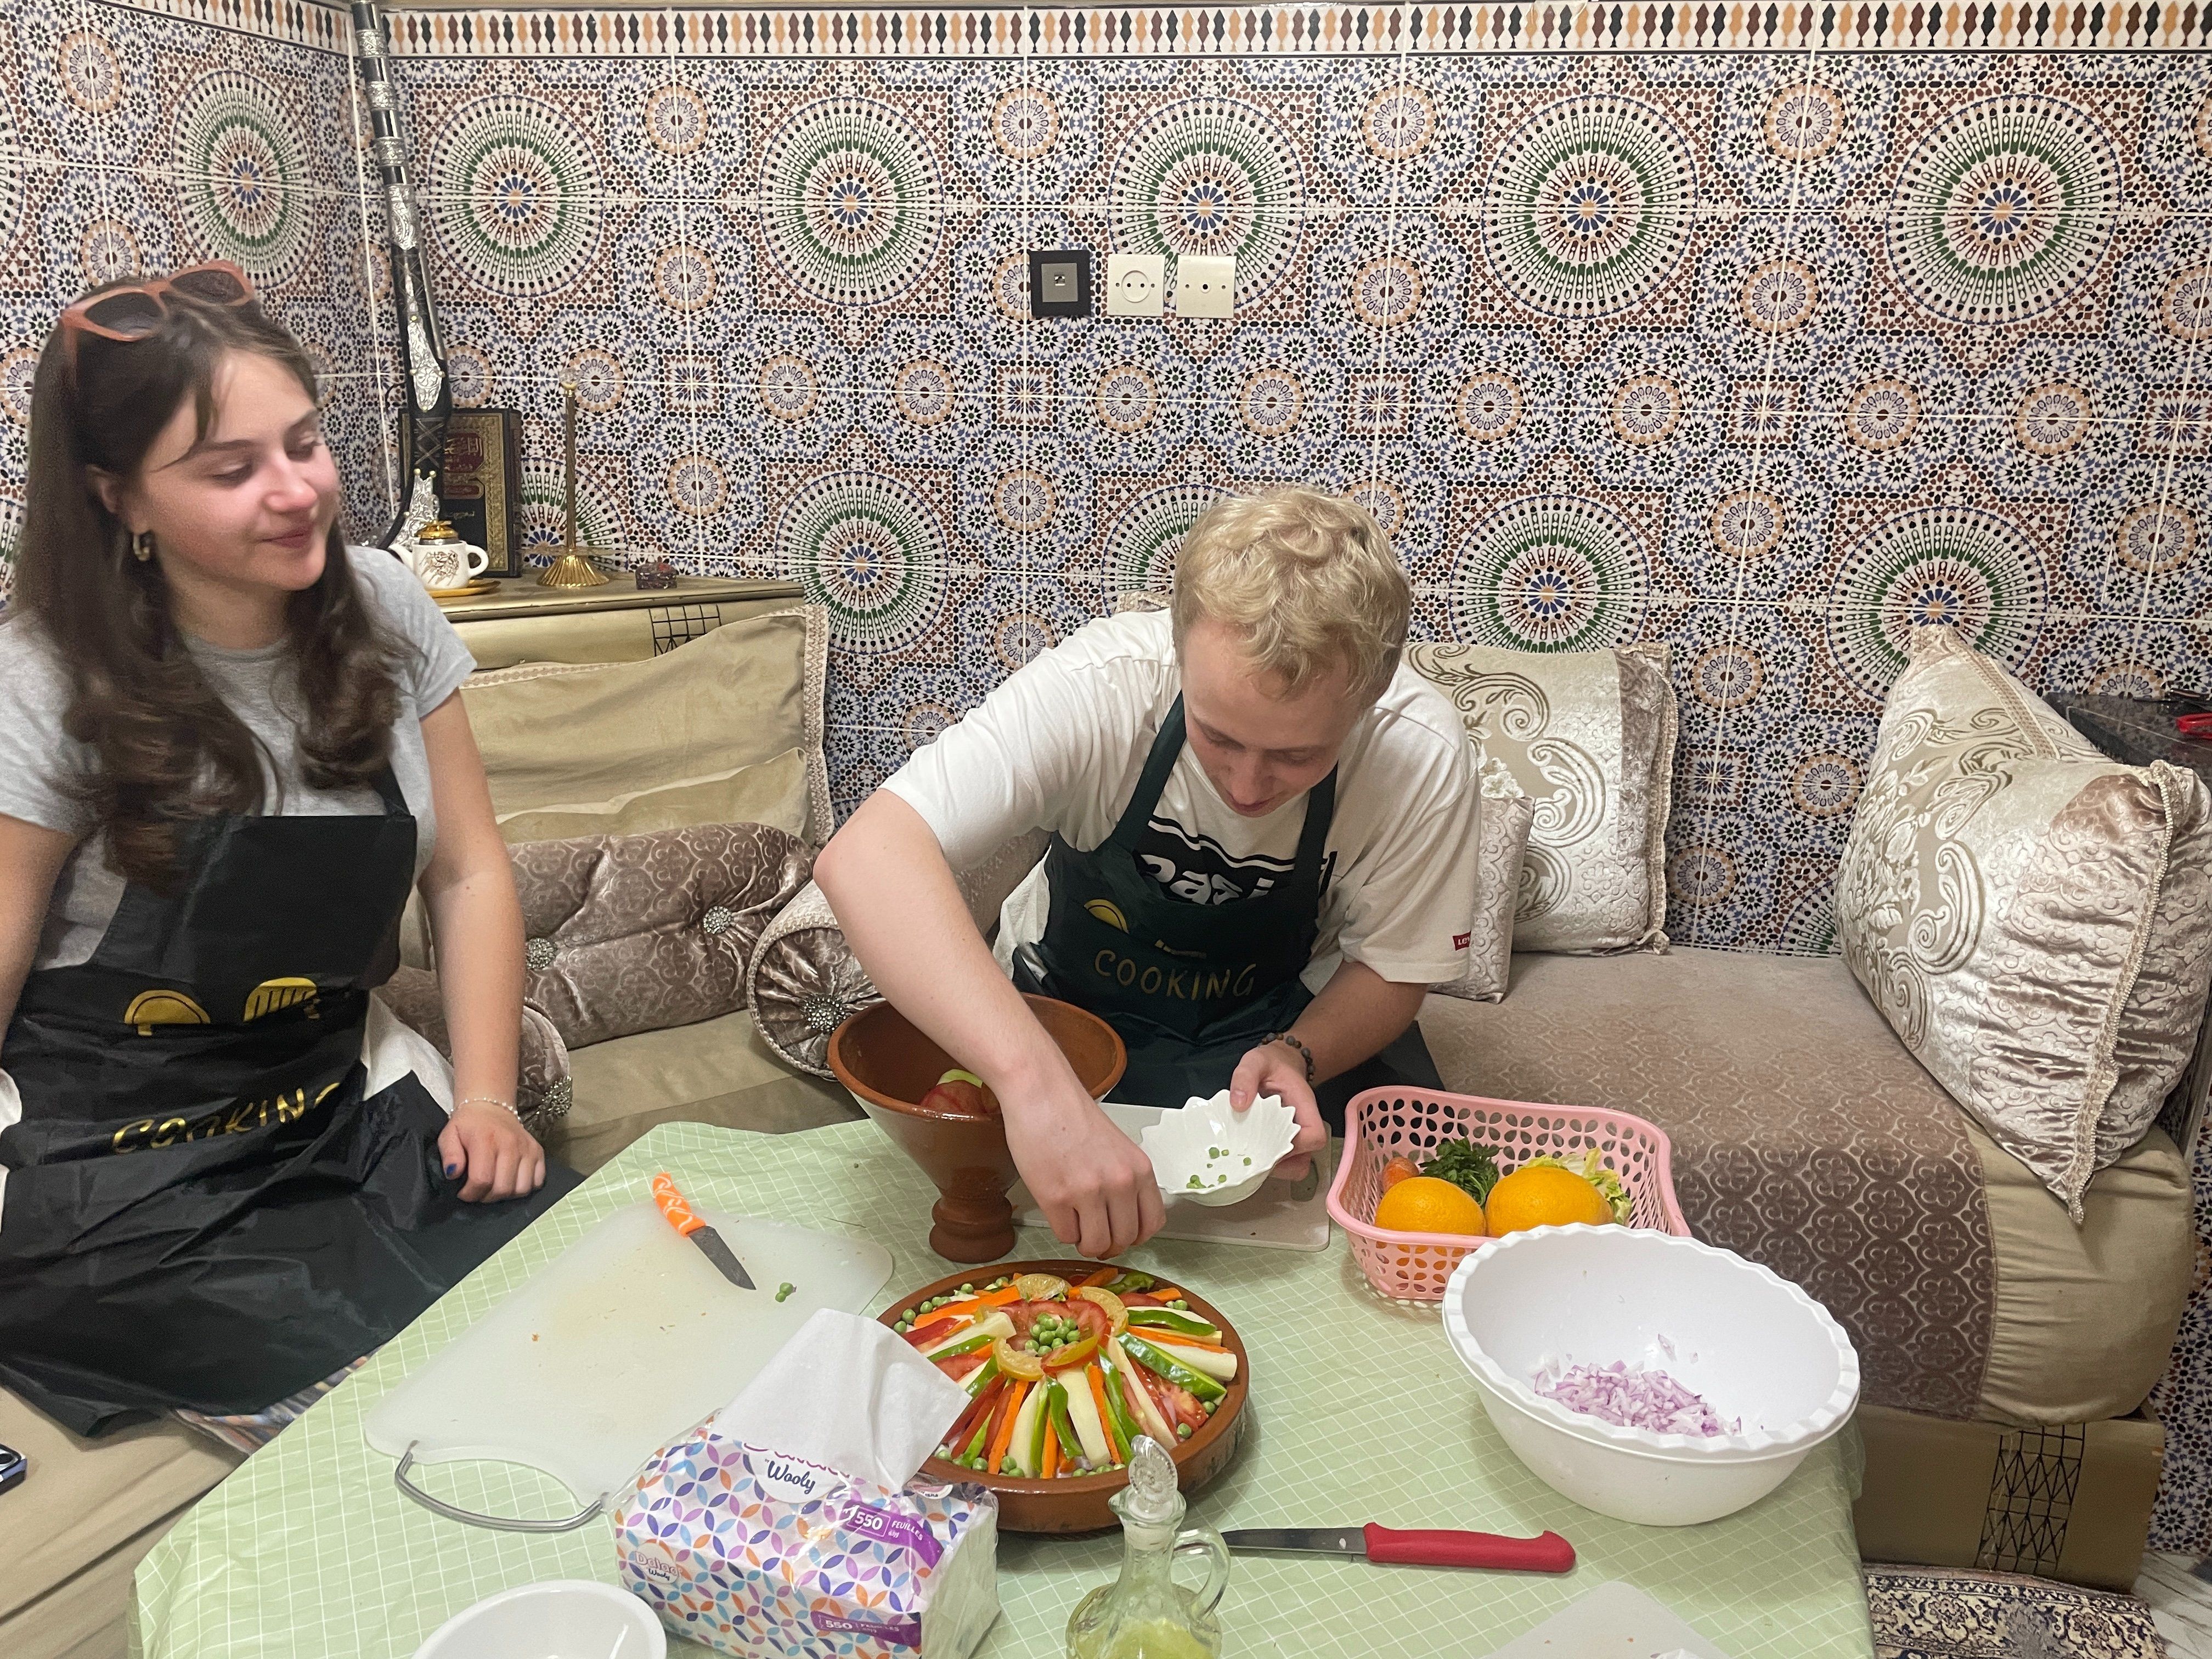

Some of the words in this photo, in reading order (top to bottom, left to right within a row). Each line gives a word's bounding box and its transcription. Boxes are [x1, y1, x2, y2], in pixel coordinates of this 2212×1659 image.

[1094, 950, 1256, 1001] COOKING
[768, 1460, 816, 1494] Wooly
[854, 1511, 883, 1530] 550
[891, 1520, 923, 1541] FEUILLES
[825, 1620, 853, 1629] 550
